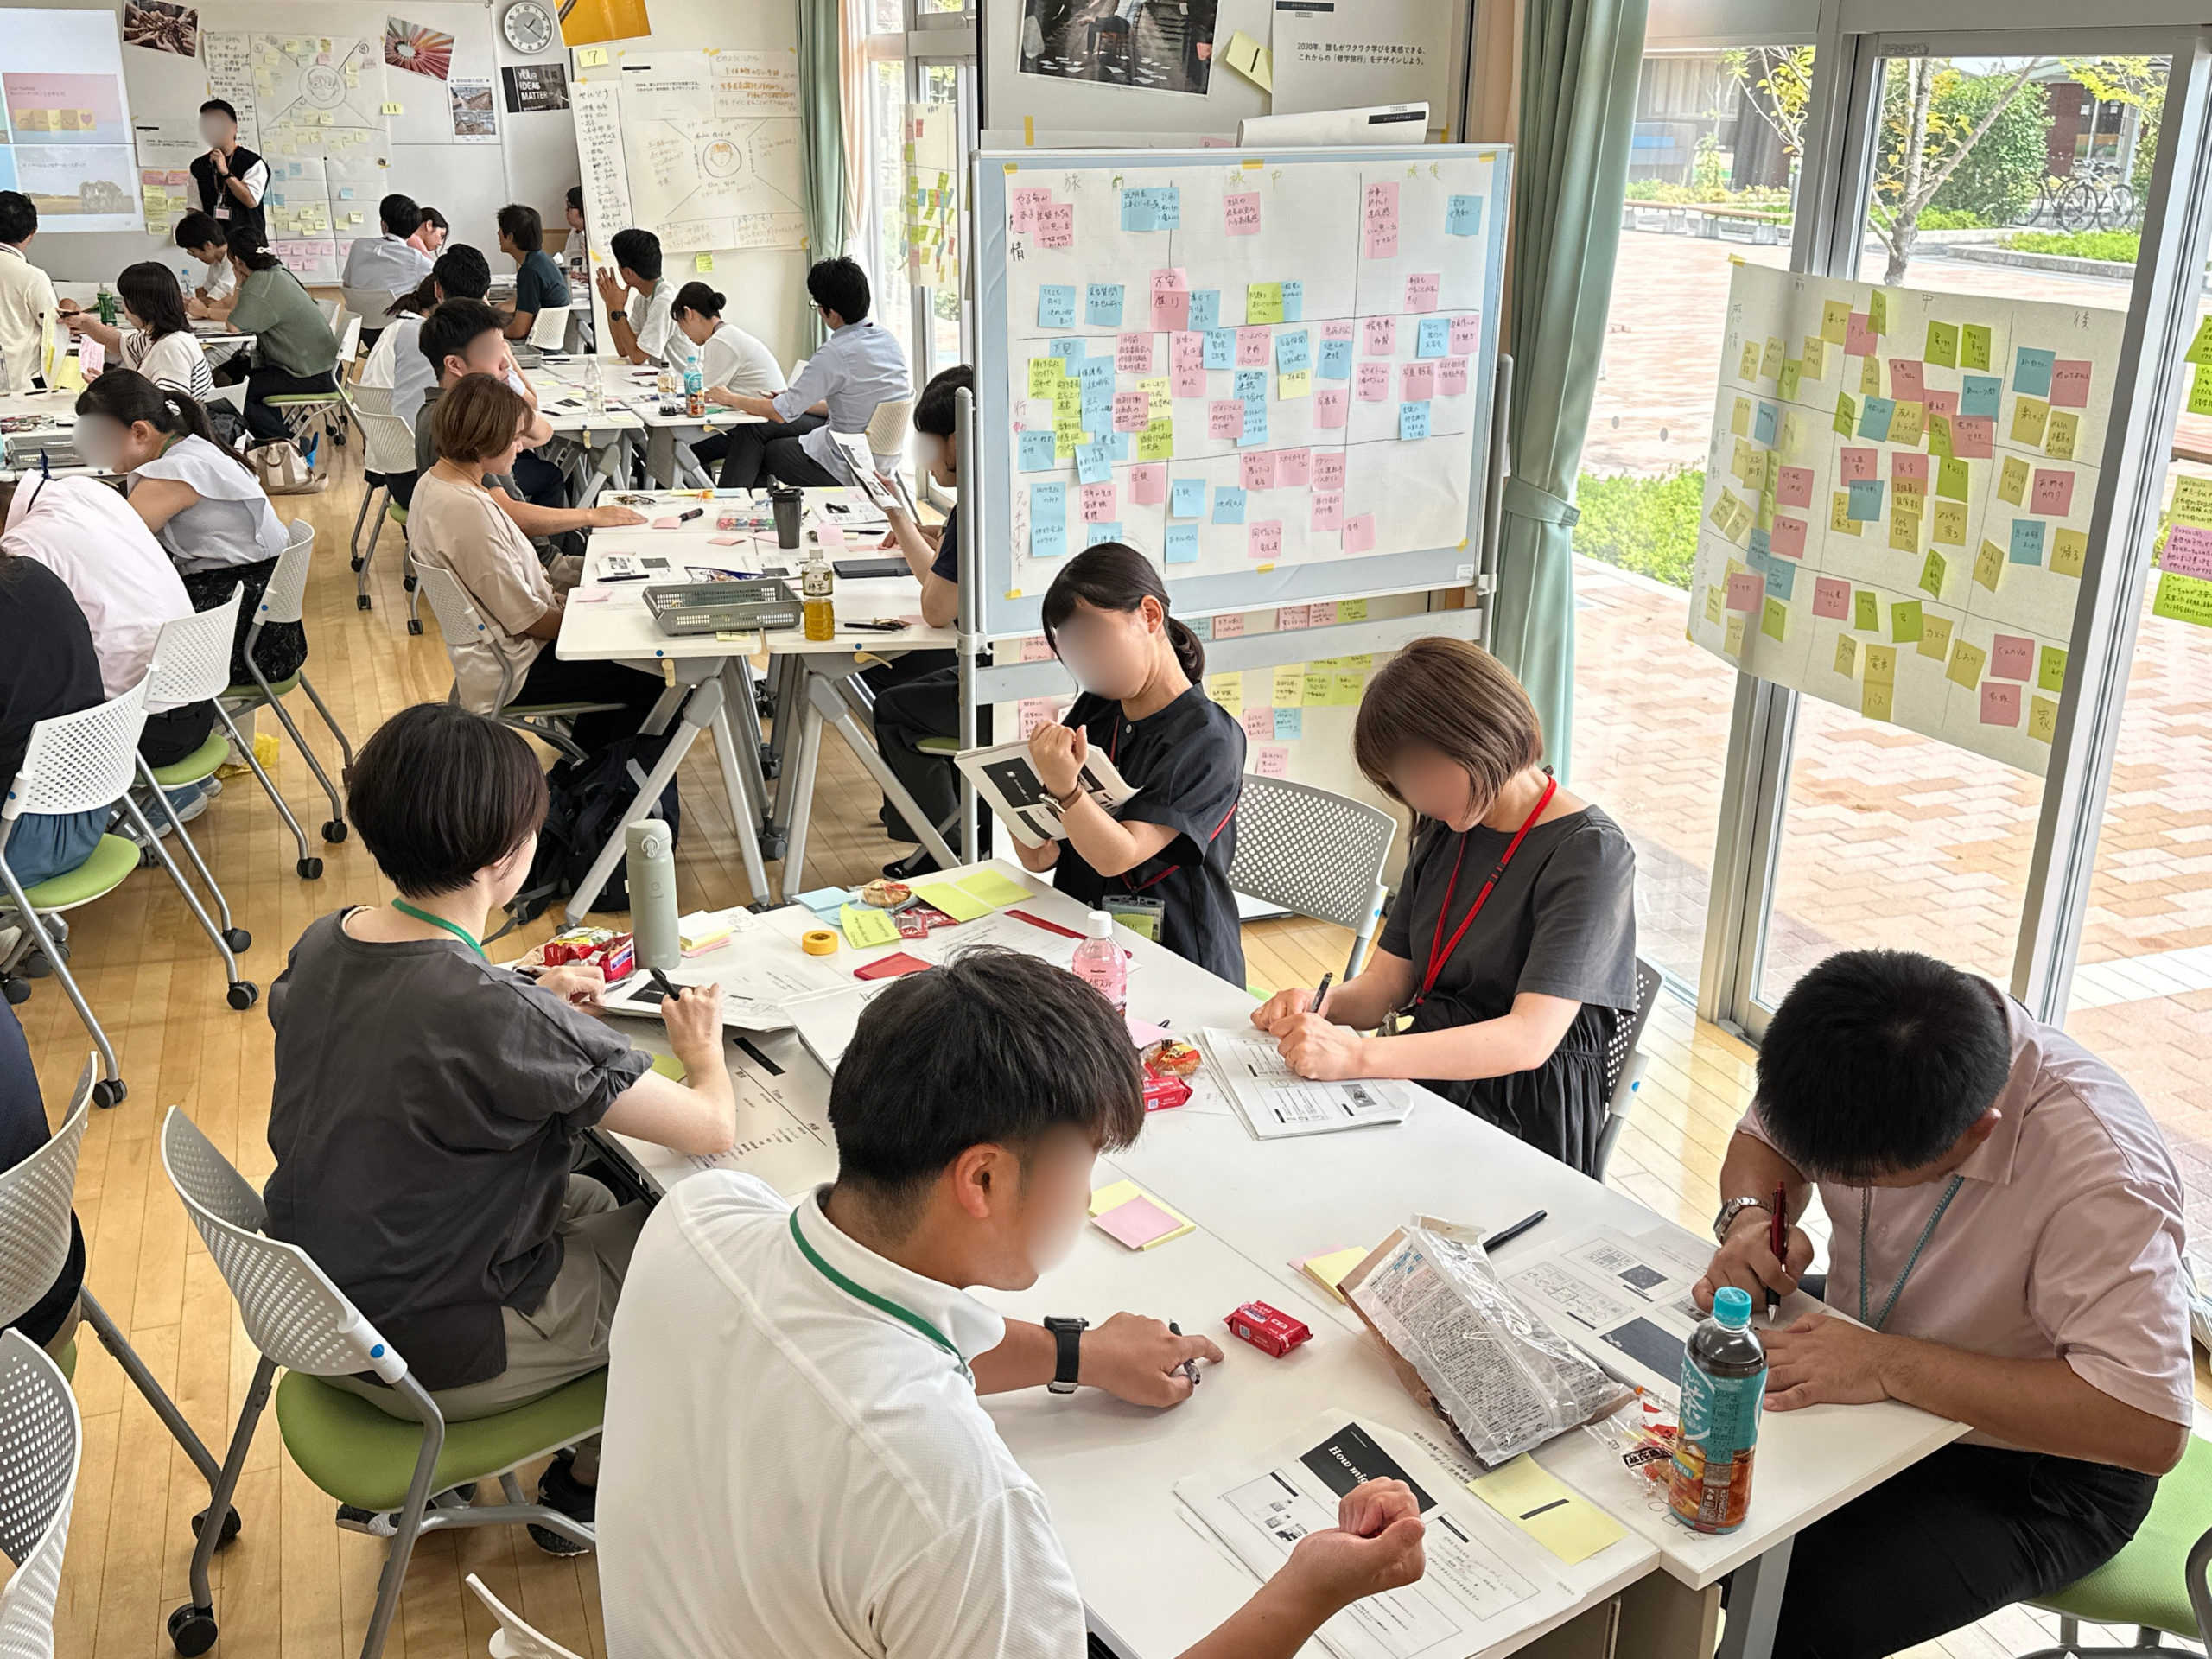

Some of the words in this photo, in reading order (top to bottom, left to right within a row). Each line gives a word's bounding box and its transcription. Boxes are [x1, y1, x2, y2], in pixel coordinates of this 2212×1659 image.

[588, 50, 598, 64] 7
[1299, 54, 1425, 66] これからの「修学旅行」をデザインしよう。
[518, 69, 537, 79] YOUR
[519, 81, 541, 90] IDEAS
[521, 91, 548, 100] MATTER
[1020, 209, 1035, 219] ある
[1155, 275, 1176, 288] 不安
[1795, 275, 1805, 291] 前
[1154, 296, 1179, 308] 焦り
[1922, 294, 1934, 312] 中
[1827, 311, 1846, 325] 楽しみ
[2074, 311, 2090, 330] 後
[1728, 303, 1742, 349] 感情
[1053, 342, 1072, 355] 下見
[1082, 366, 1103, 378] 保護者
[1087, 378, 1110, 390] 説明会
[1897, 408, 1916, 418] 友人と
[1896, 422, 1919, 432] トラブル
[1897, 483, 1918, 493] 班員と
[1217, 499, 1244, 508] 地域の人
[1897, 497, 1918, 509] 見学する
[2060, 545, 2079, 561] 帰る
[1926, 627, 1945, 640] カメラ
[1871, 655, 1888, 671] 電車
[1956, 650, 1978, 666] しおり
[1867, 693, 1884, 706] バス
[2037, 706, 2051, 731] 家
[772, 1089, 783, 1100] Time
[1682, 1382, 1707, 1421] 茶
[1328, 1445, 1352, 1468] How
[1350, 1465, 1370, 1484] mig
